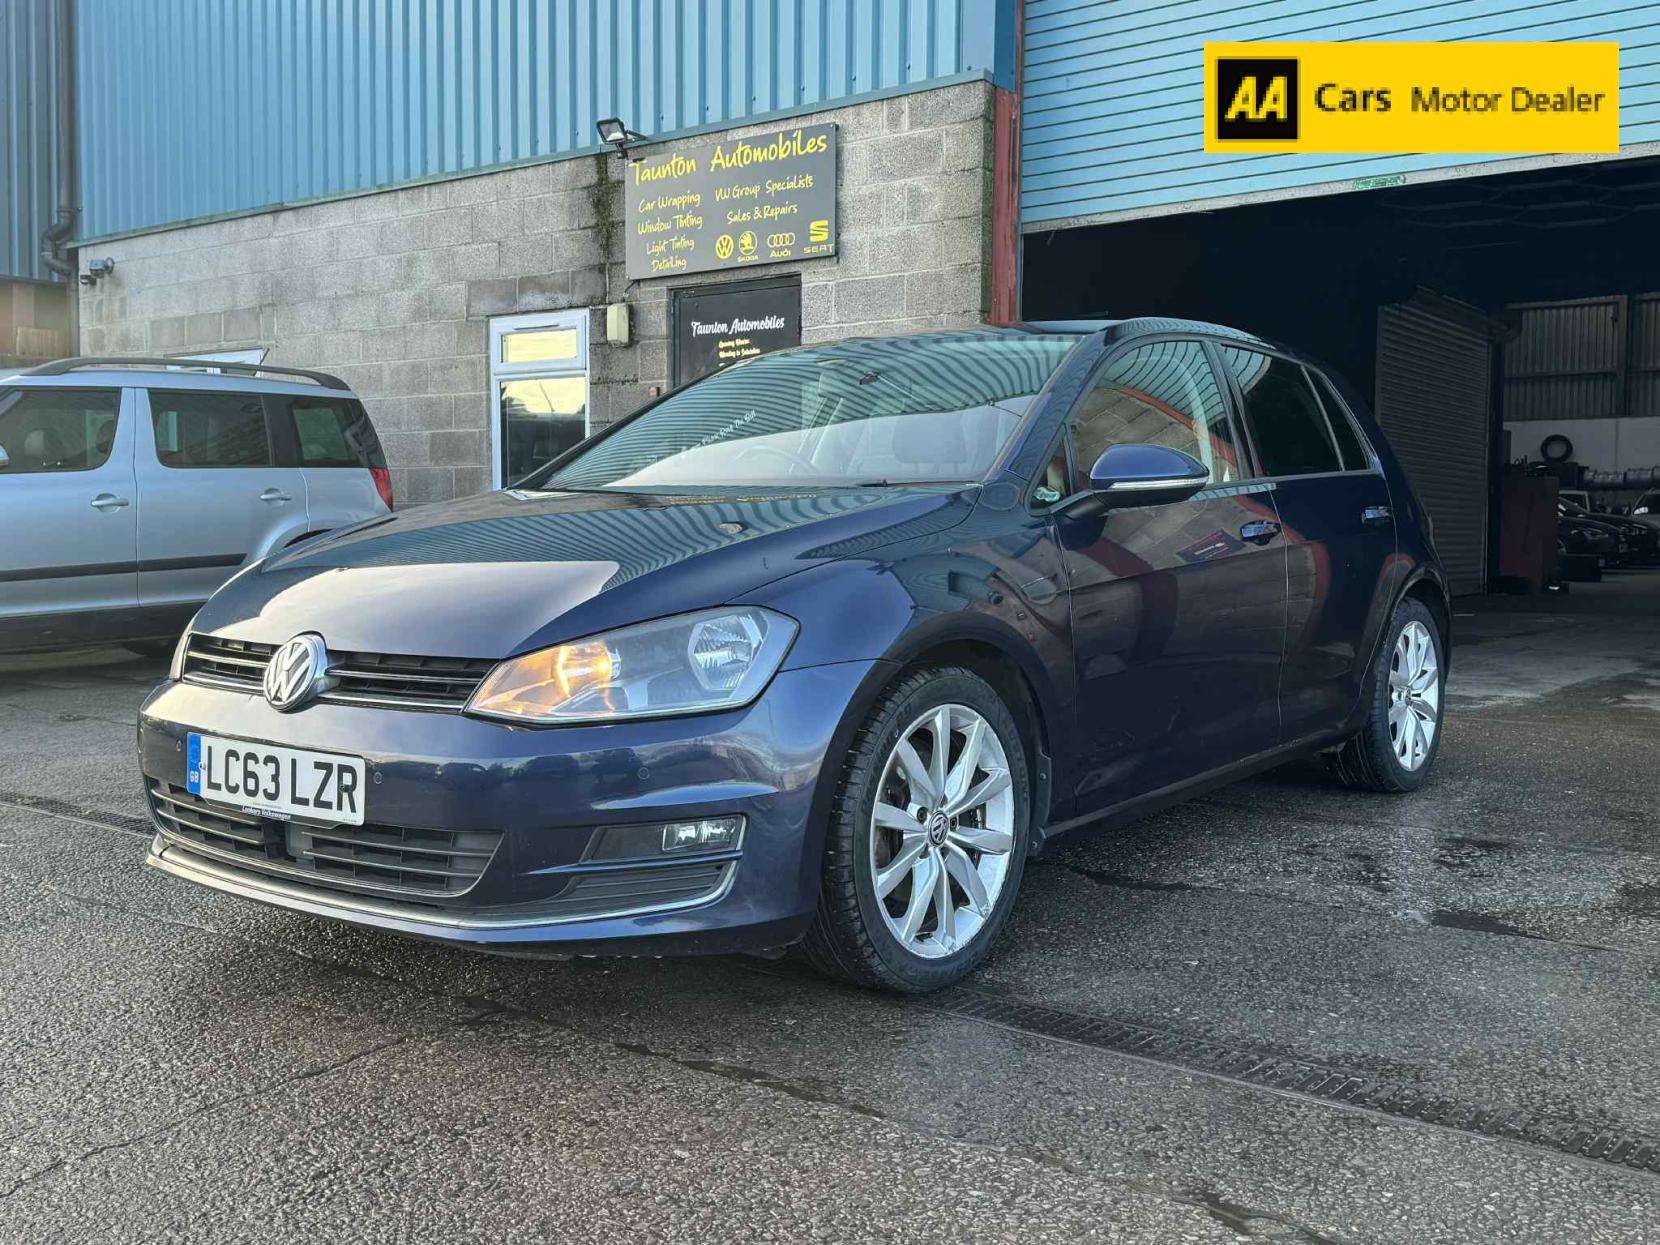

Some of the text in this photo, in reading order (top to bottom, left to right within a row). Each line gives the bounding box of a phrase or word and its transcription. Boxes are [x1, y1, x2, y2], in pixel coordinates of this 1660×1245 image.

[628, 129, 828, 187] Taunton Automobiles
[715, 173, 814, 202] VW Group Specialists
[638, 190, 701, 213] Car Wrapping
[726, 200, 799, 225] Sales & Repairs
[638, 210, 703, 234] Window Tinting
[646, 235, 695, 257] Light Tinting
[769, 249, 792, 258] Audi
[803, 243, 834, 254] SEAT
[651, 256, 687, 272] Detailing
[691, 315, 785, 337] Taunton Automobiles
[189, 770, 200, 784] GB
[207, 745, 358, 814] LC63 LZR
